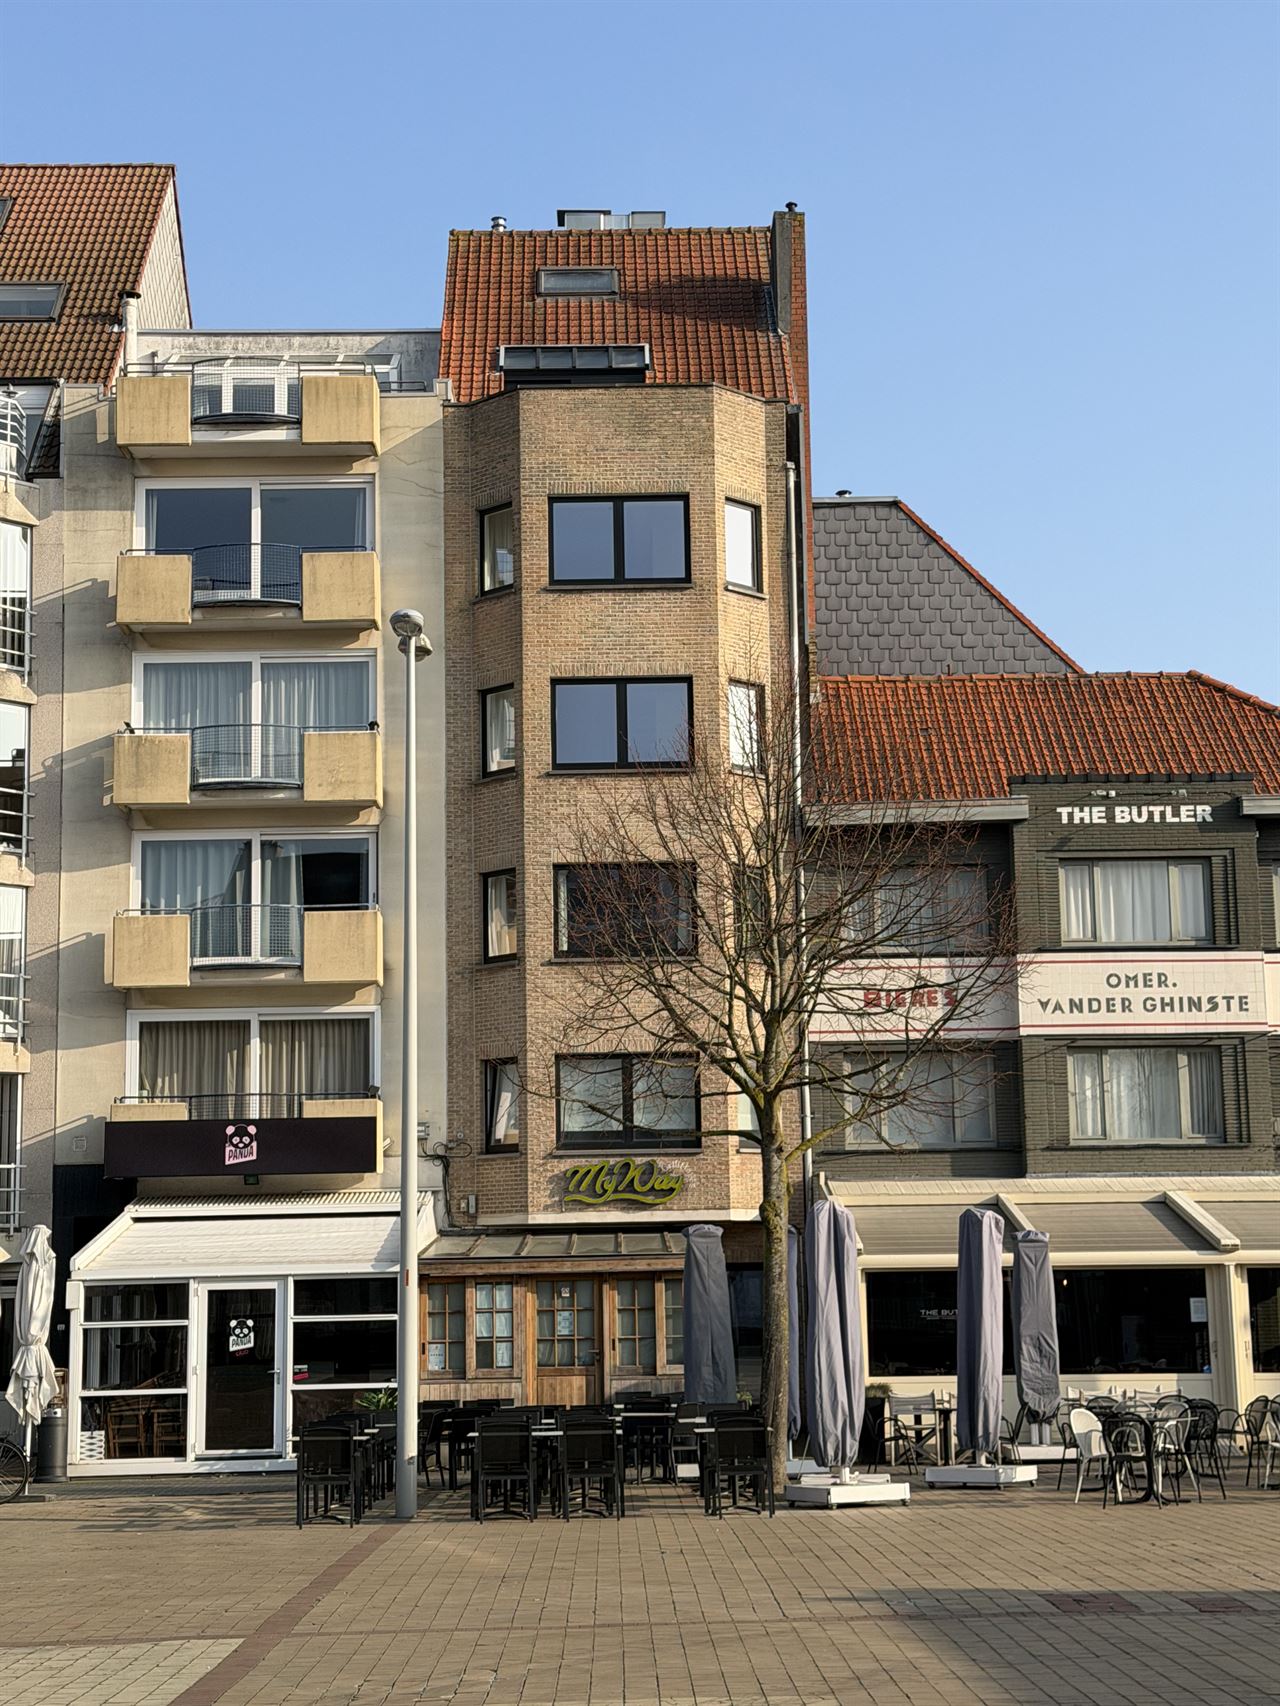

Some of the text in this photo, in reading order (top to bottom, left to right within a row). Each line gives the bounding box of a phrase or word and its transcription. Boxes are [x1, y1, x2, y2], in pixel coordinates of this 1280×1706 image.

[1056, 804, 1213, 824] THE BUTLER
[1105, 972, 1178, 989] OMER.
[1038, 995, 1250, 1014] VANDER GHINSTE
[227, 1145, 254, 1162] PANDA
